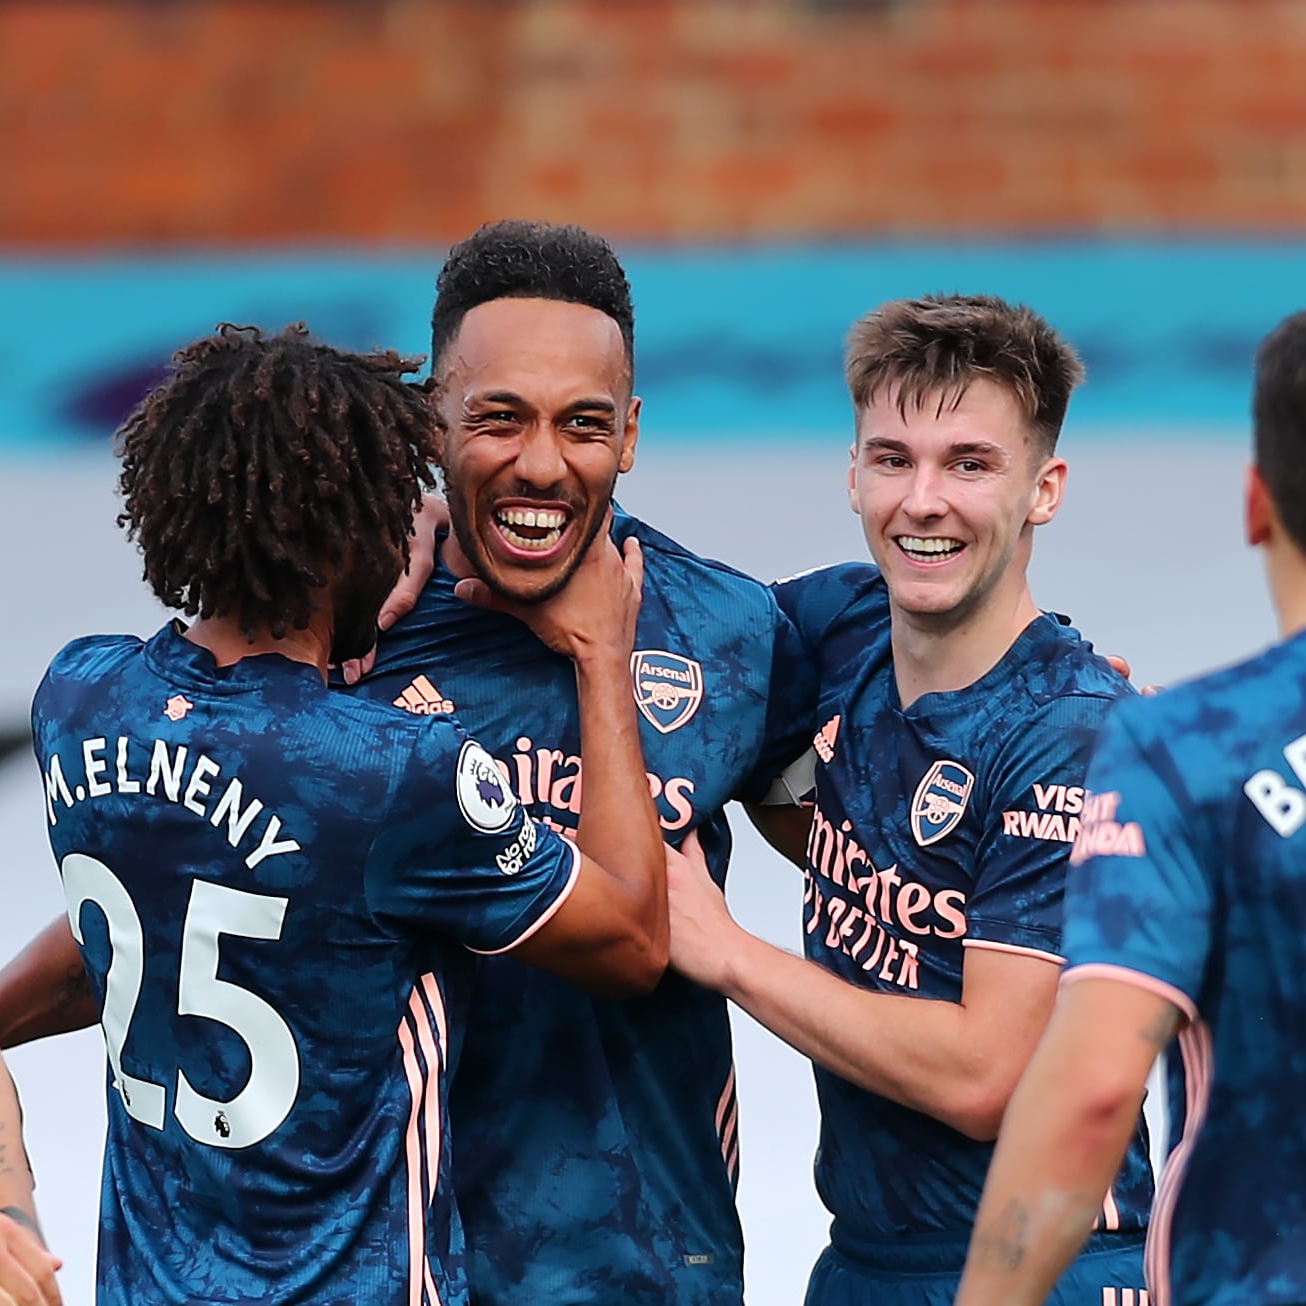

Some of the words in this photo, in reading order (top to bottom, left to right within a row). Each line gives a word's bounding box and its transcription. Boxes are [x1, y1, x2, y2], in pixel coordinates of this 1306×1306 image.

[640, 663, 691, 683] Arsenal
[45, 737, 301, 871] M.ELNENY
[933, 774, 968, 799] Arsenal
[807, 803, 967, 939] mirates
[825, 897, 919, 989] BETTER
[62, 853, 300, 1149] 25
